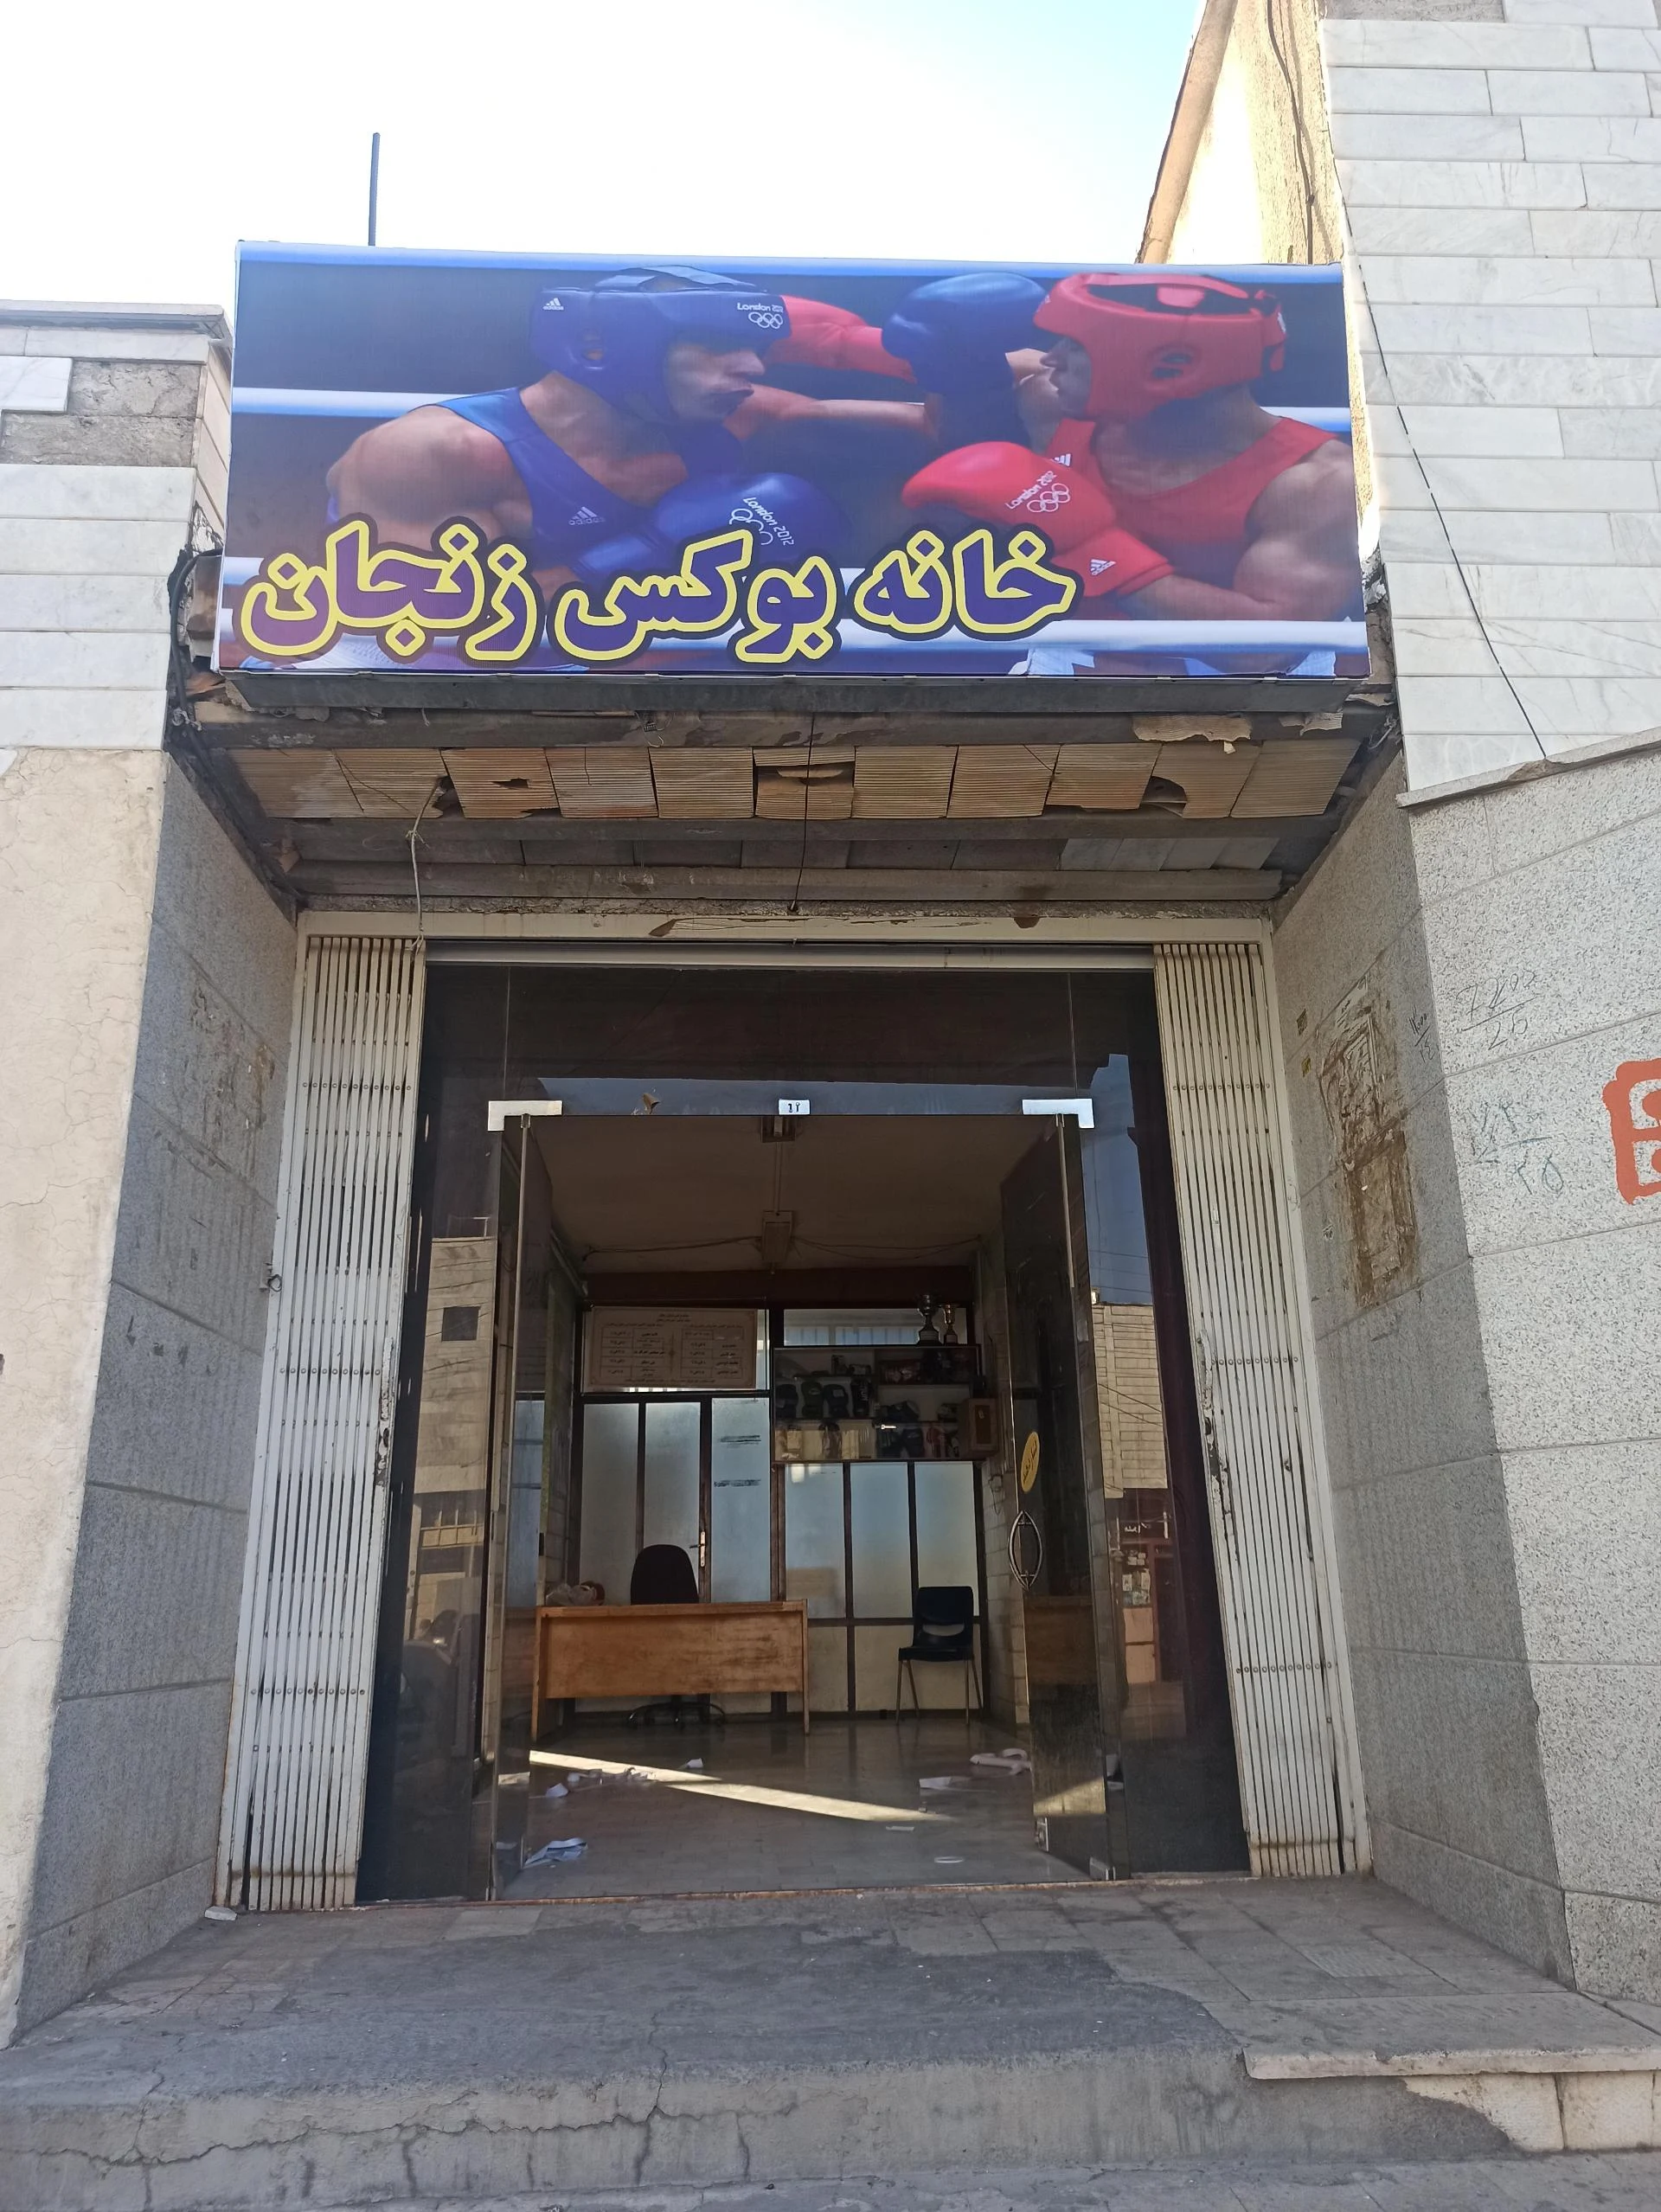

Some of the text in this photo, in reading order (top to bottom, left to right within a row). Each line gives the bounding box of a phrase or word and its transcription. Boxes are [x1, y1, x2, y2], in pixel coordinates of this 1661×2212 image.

[737, 302, 771, 311] London
[1004, 484, 1042, 510] London
[743, 497, 795, 546] London 2012
[240, 519, 1077, 662] خانه بوکس زنجان
